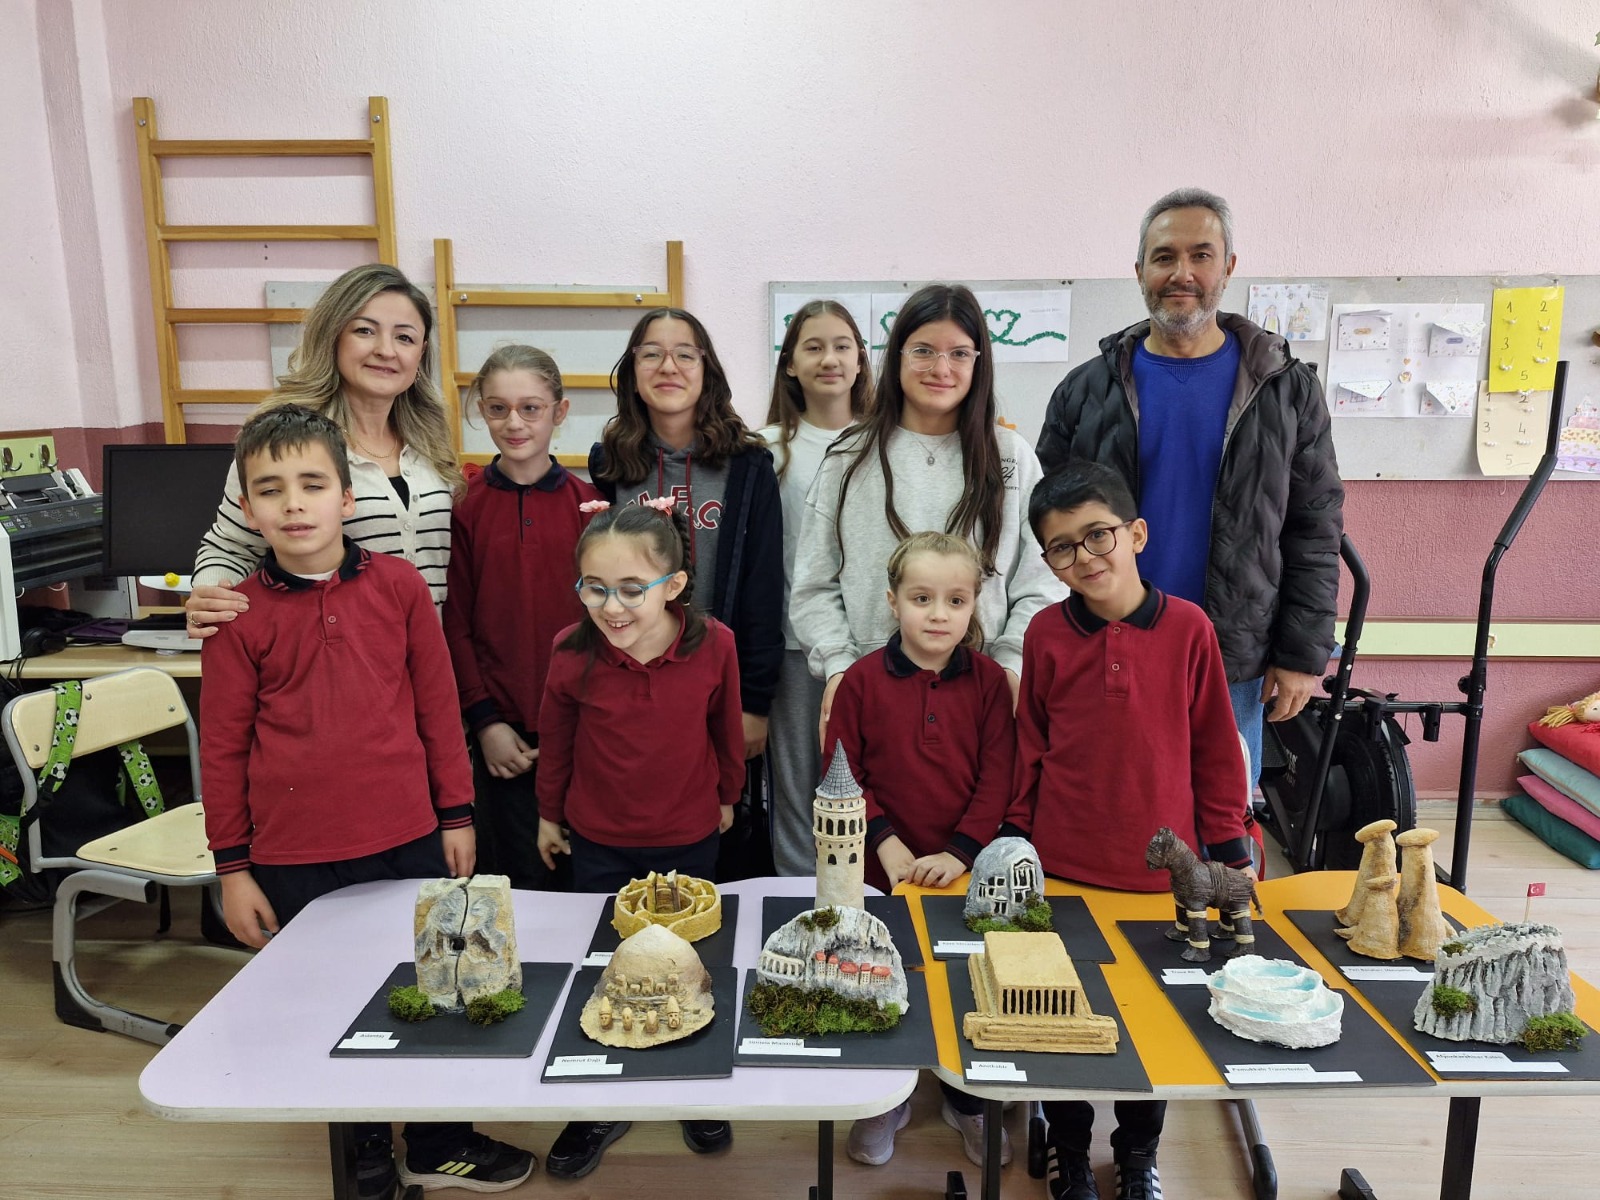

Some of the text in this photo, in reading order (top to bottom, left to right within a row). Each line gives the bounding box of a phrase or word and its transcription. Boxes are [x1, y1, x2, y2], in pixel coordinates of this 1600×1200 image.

[1506, 301, 1548, 313] 1 2
[1501, 337, 1544, 350] 3 4
[1520, 370, 1529, 381] 5
[1486, 392, 1529, 404] 1 2
[1483, 421, 1527, 434] 3 4
[1505, 453, 1514, 466] 5
